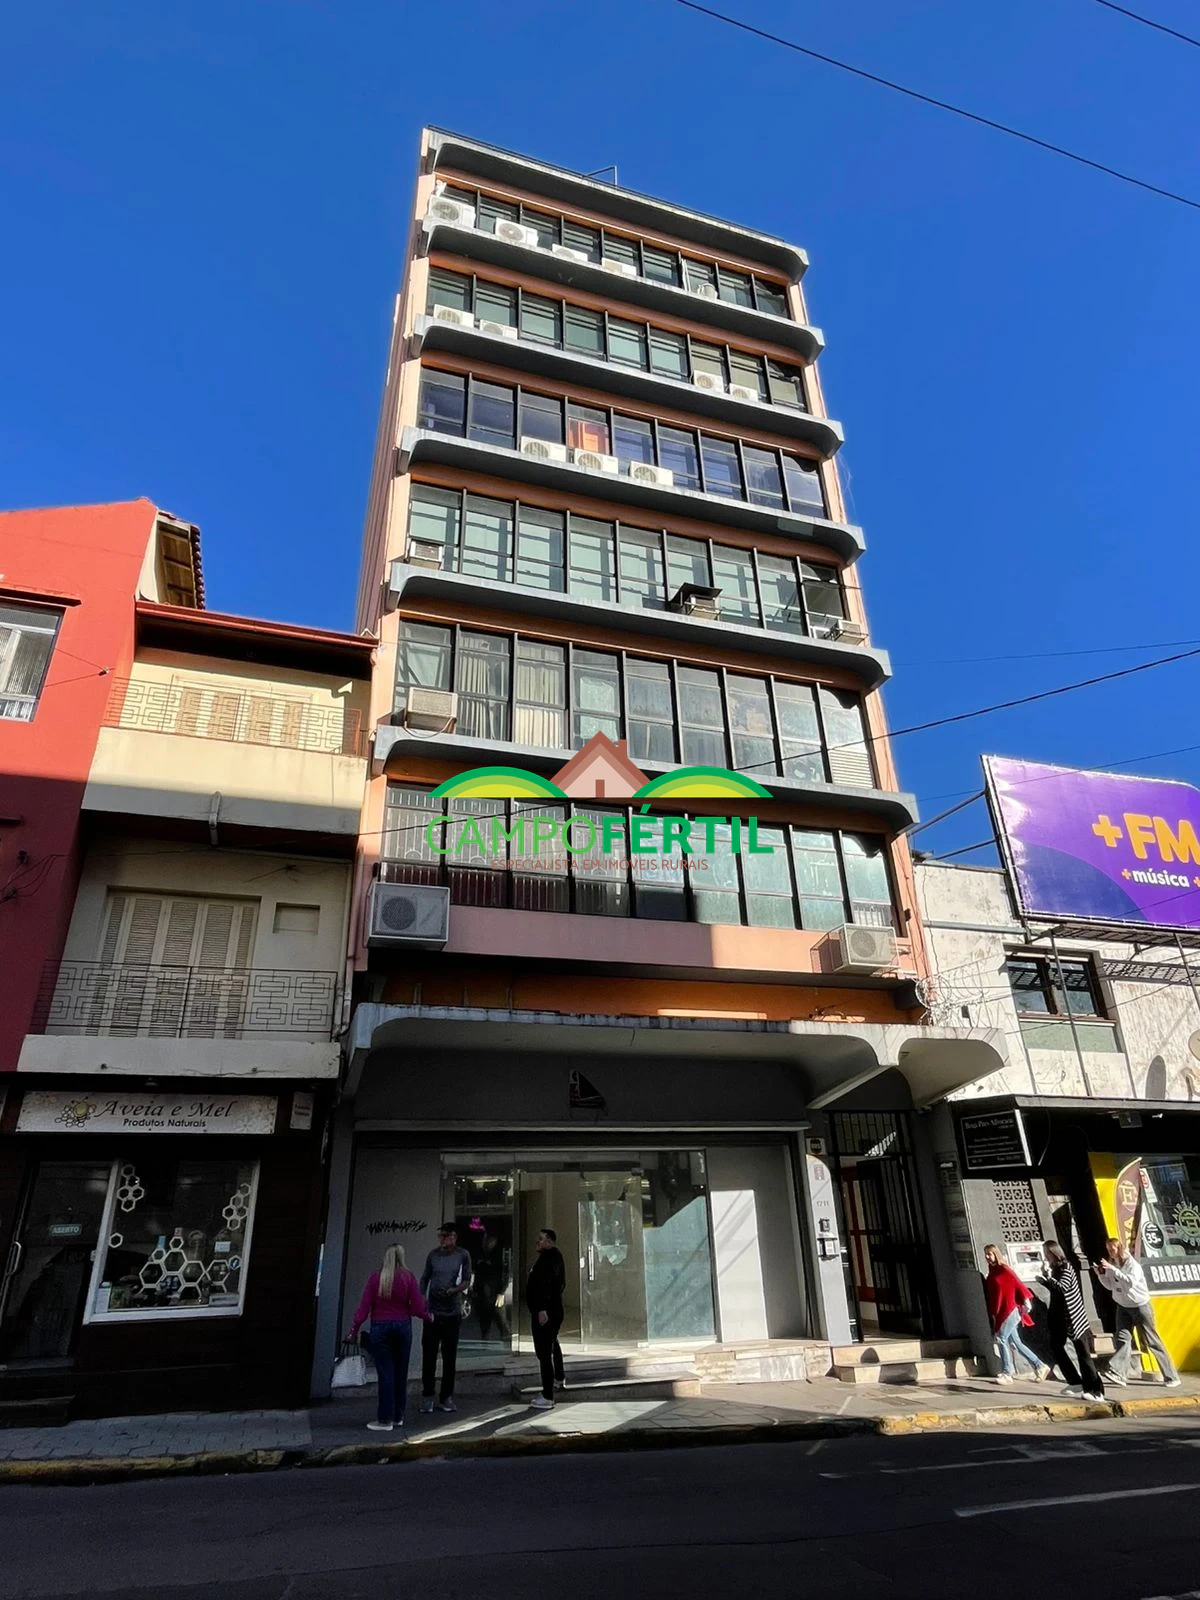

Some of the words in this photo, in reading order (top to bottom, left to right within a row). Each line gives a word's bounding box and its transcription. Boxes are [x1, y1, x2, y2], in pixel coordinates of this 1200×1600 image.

[95, 1099, 164, 1118] Aveia
[170, 1106, 185, 1117] e
[188, 1101, 237, 1118] Mel
[123, 1118, 165, 1127] Produtos
[168, 1119, 207, 1128] Naturais
